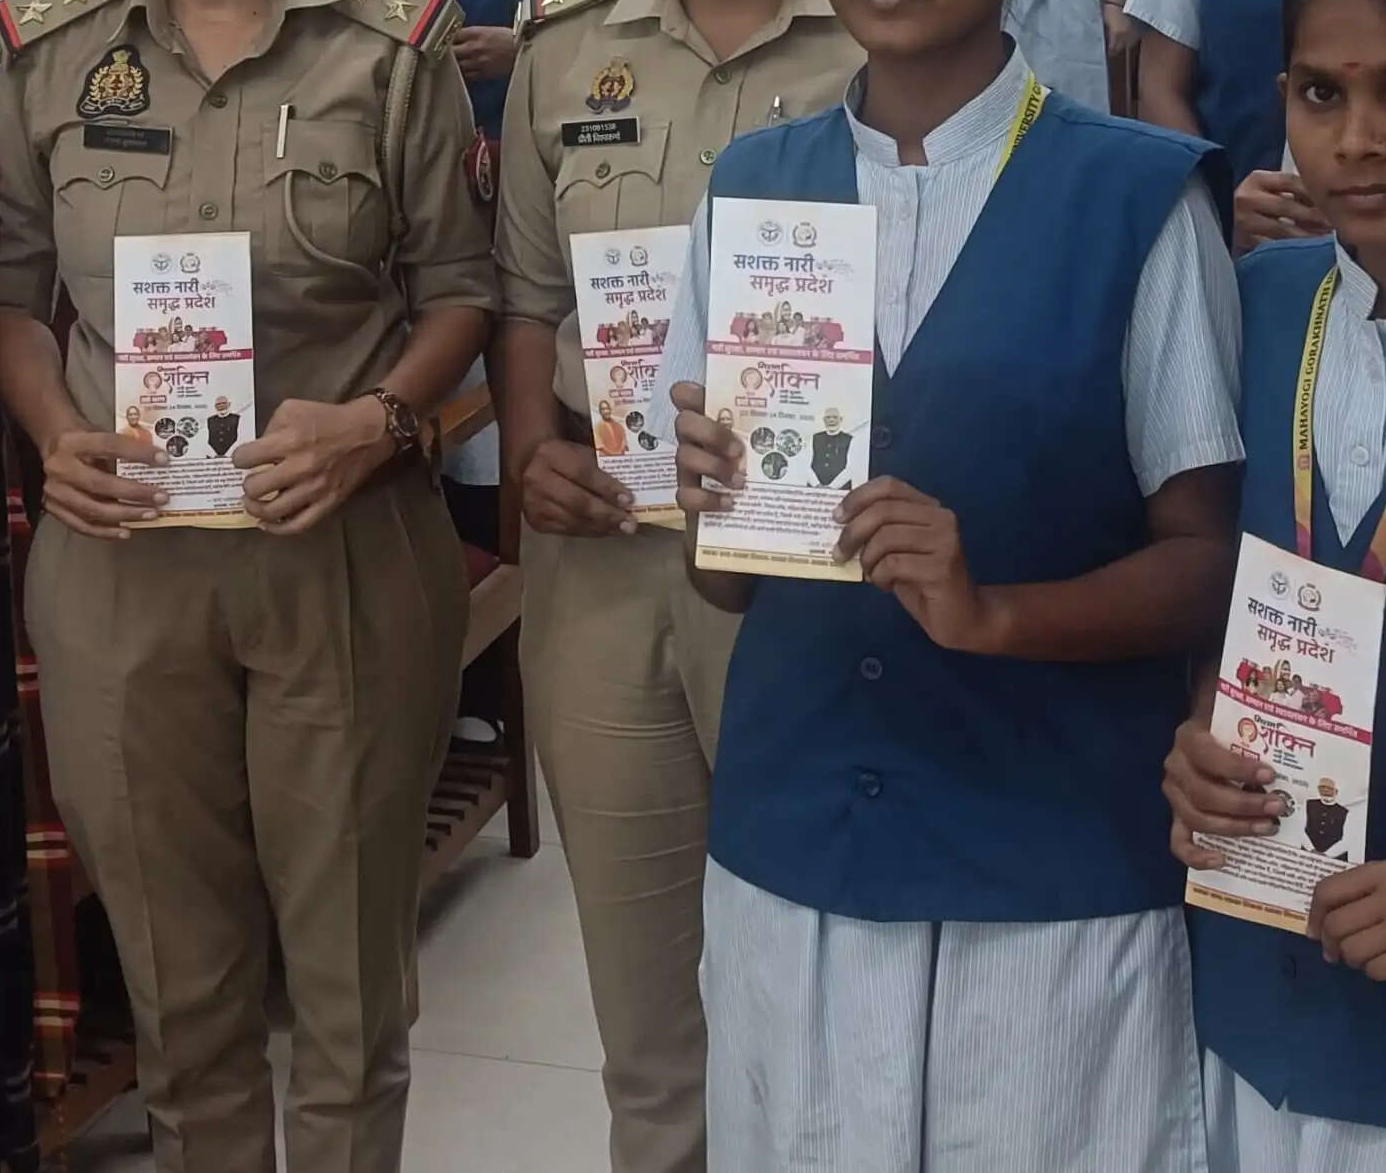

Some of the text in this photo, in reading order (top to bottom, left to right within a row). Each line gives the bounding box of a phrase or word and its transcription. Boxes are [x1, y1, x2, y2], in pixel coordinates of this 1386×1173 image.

[733, 253, 815, 273] सशक्त नारी
[133, 278, 199, 294] सशक्त नारी
[590, 270, 650, 290] सशक्त नारी
[749, 274, 834, 296] समृद्ध प्रदेश
[147, 295, 215, 313] समृद्ध प्रदेश
[605, 287, 667, 309] समृद्ध प्रदेश
[1299, 287, 1330, 450] MAHAYOGI GORAKHNATH
[1247, 596, 1317, 637] सशक्त नारी
[1257, 624, 1335, 663] समृद्ध प्रदेश
